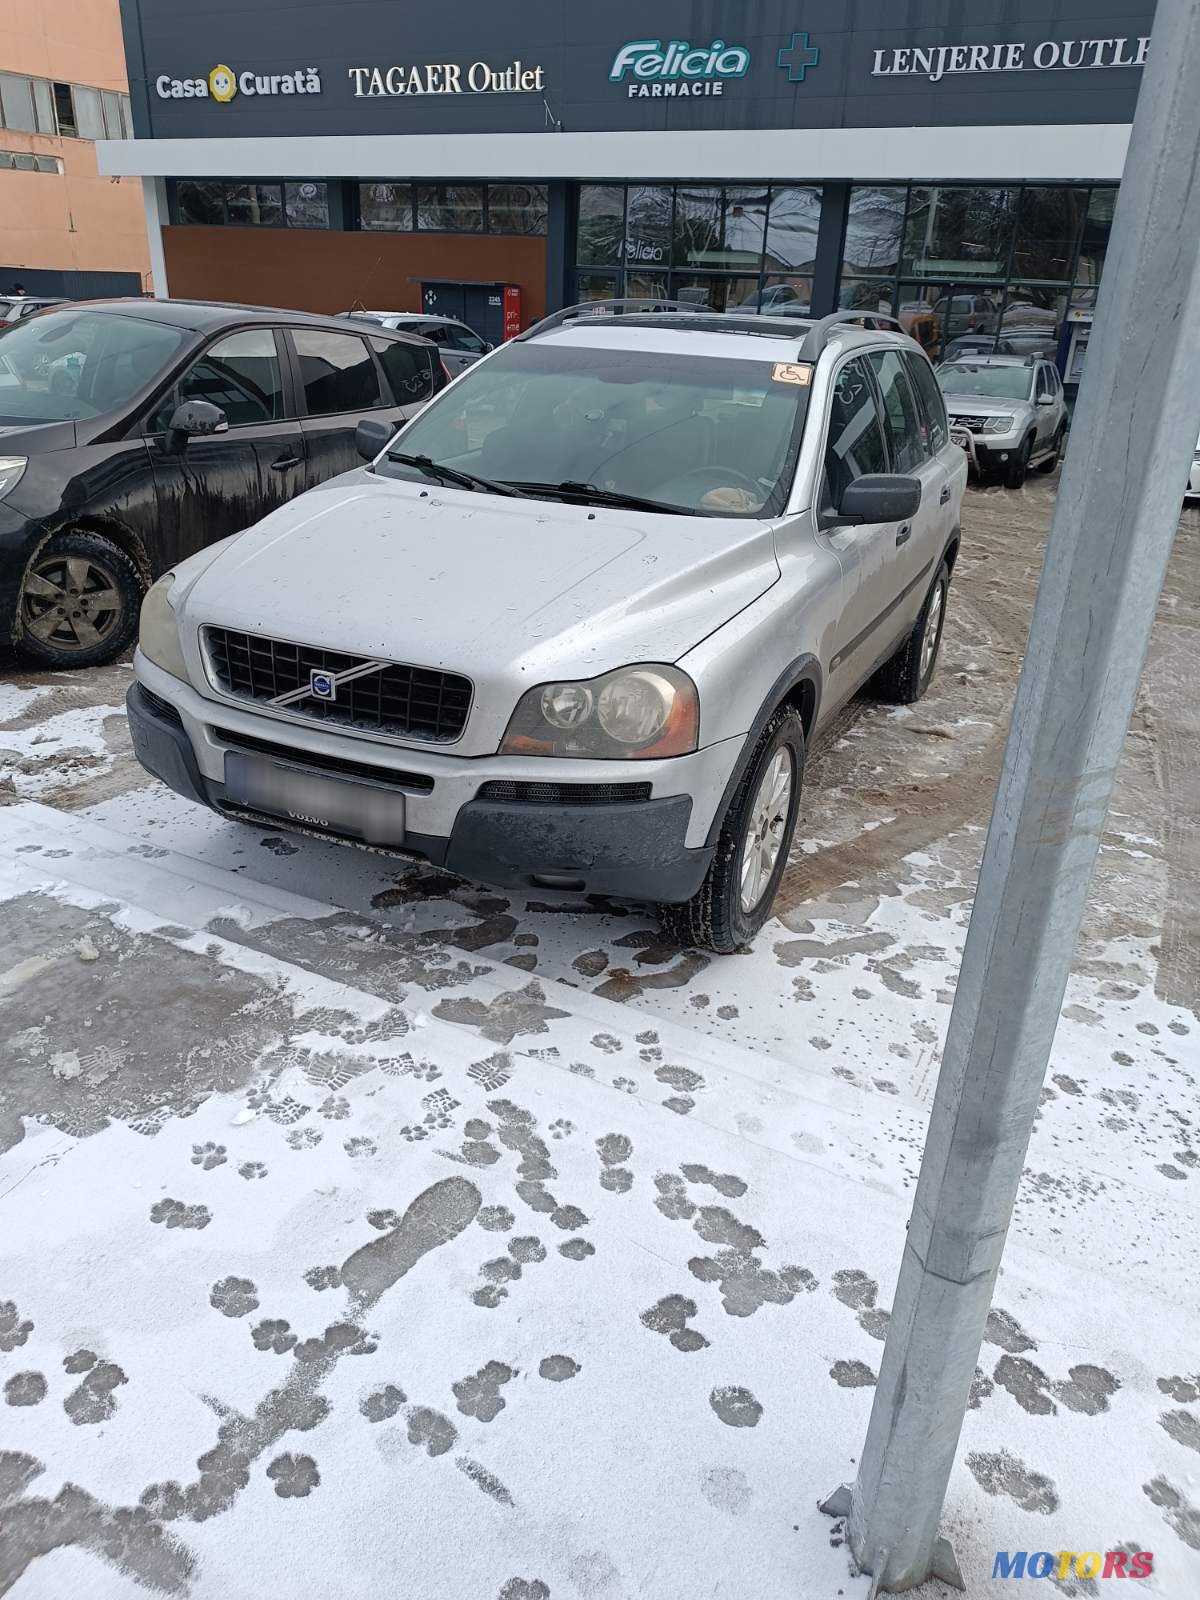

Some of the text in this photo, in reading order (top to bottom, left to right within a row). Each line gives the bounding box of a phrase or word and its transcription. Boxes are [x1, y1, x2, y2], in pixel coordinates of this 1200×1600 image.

[609, 40, 750, 81] Felicia
[871, 43, 1025, 82] LENJERIE
[156, 67, 321, 99] Casa Curată
[349, 61, 545, 97] TAGAER Outlet
[628, 82, 723, 98] FARMACIE
[287, 809, 329, 826] VOLVO
